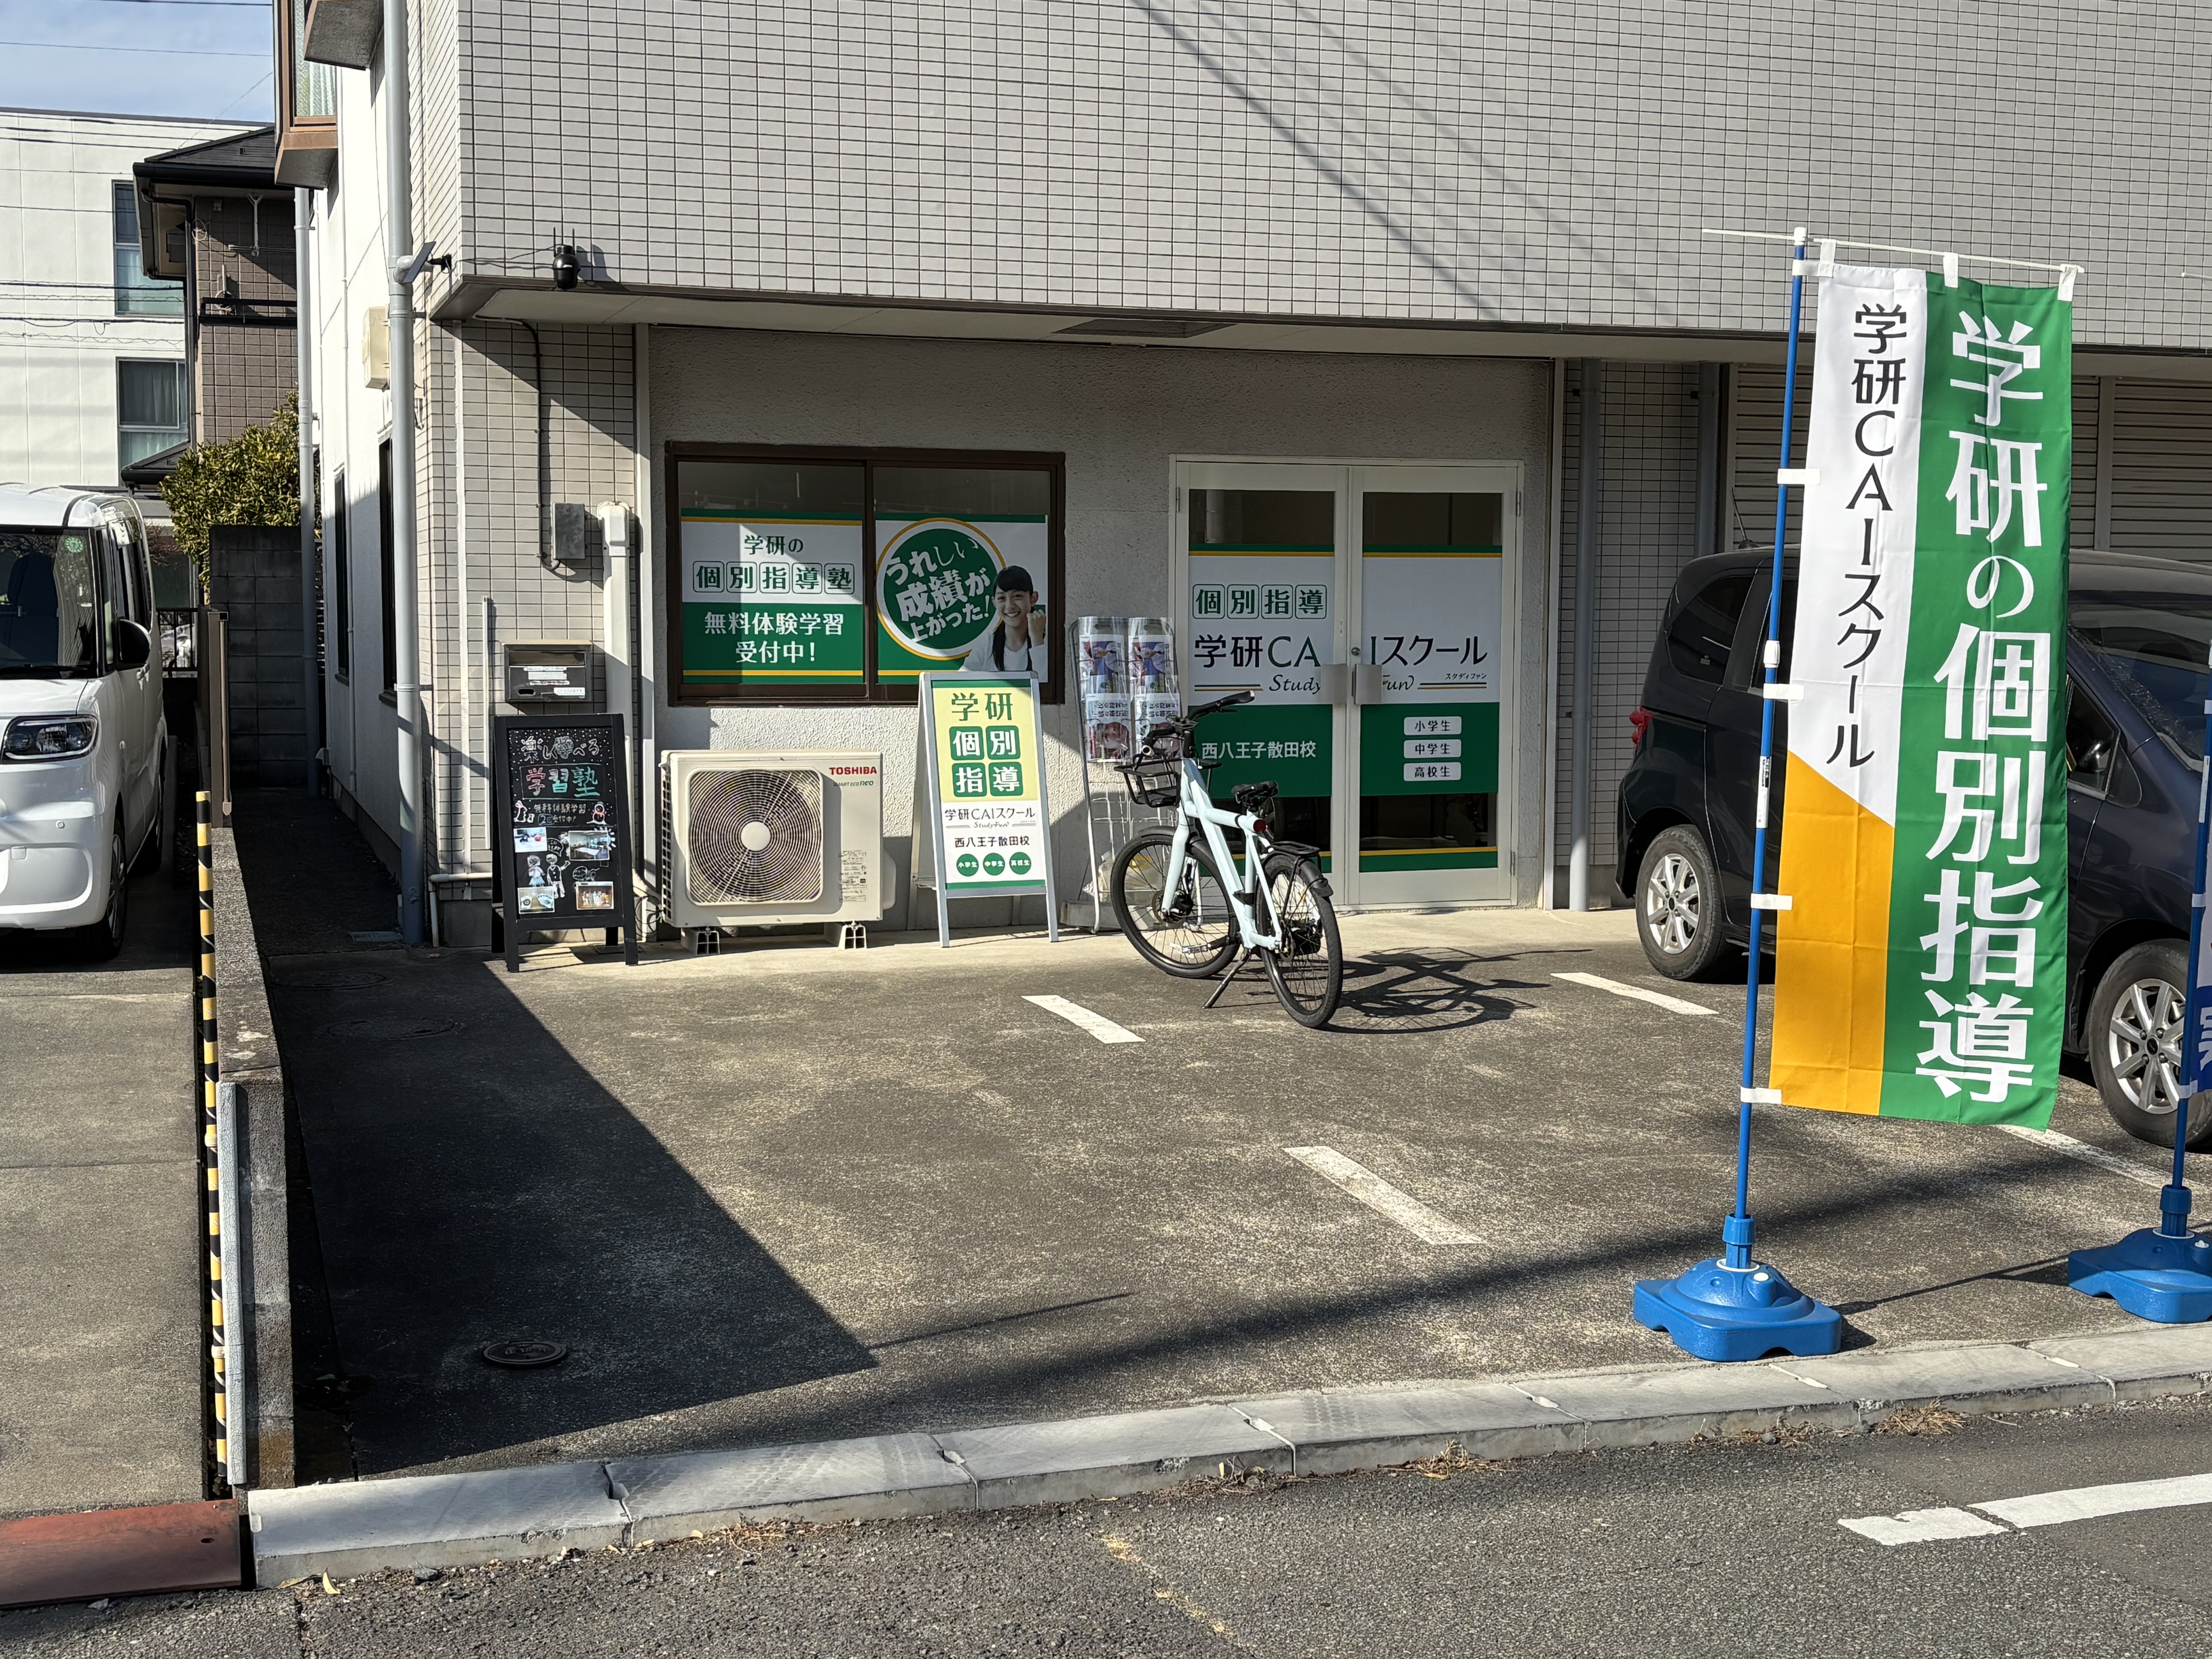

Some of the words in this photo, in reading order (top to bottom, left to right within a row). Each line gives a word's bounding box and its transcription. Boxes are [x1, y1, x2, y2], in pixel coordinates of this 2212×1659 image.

[744, 535, 804, 555] 学研の
[1827, 304, 1907, 766] 学研CAIスクール
[886, 538, 979, 585] うれしい
[696, 565, 852, 590] 個別指導塾
[895, 567, 991, 622] 成績が
[1195, 589, 1324, 615] 個別指導
[704, 611, 844, 635] 無料体験学習
[910, 595, 989, 644] 上がった！
[735, 641, 815, 663] 受付中！
[1194, 634, 1321, 668] 学研CA
[951, 692, 1013, 721] 学研
[1915, 311, 2050, 1103] 学研の個別指導
[1414, 720, 1451, 732] 小学生
[1202, 741, 1317, 759] 西八王子散田校
[1414, 743, 1451, 755] 中学生
[526, 766, 600, 797] 学習塾
[829, 766, 877, 775] TOSHIBA
[1414, 766, 1451, 778] 高校生
[945, 807, 1036, 821] 学研CAIスクール
[954, 835, 1030, 848] 西八王子散田校
